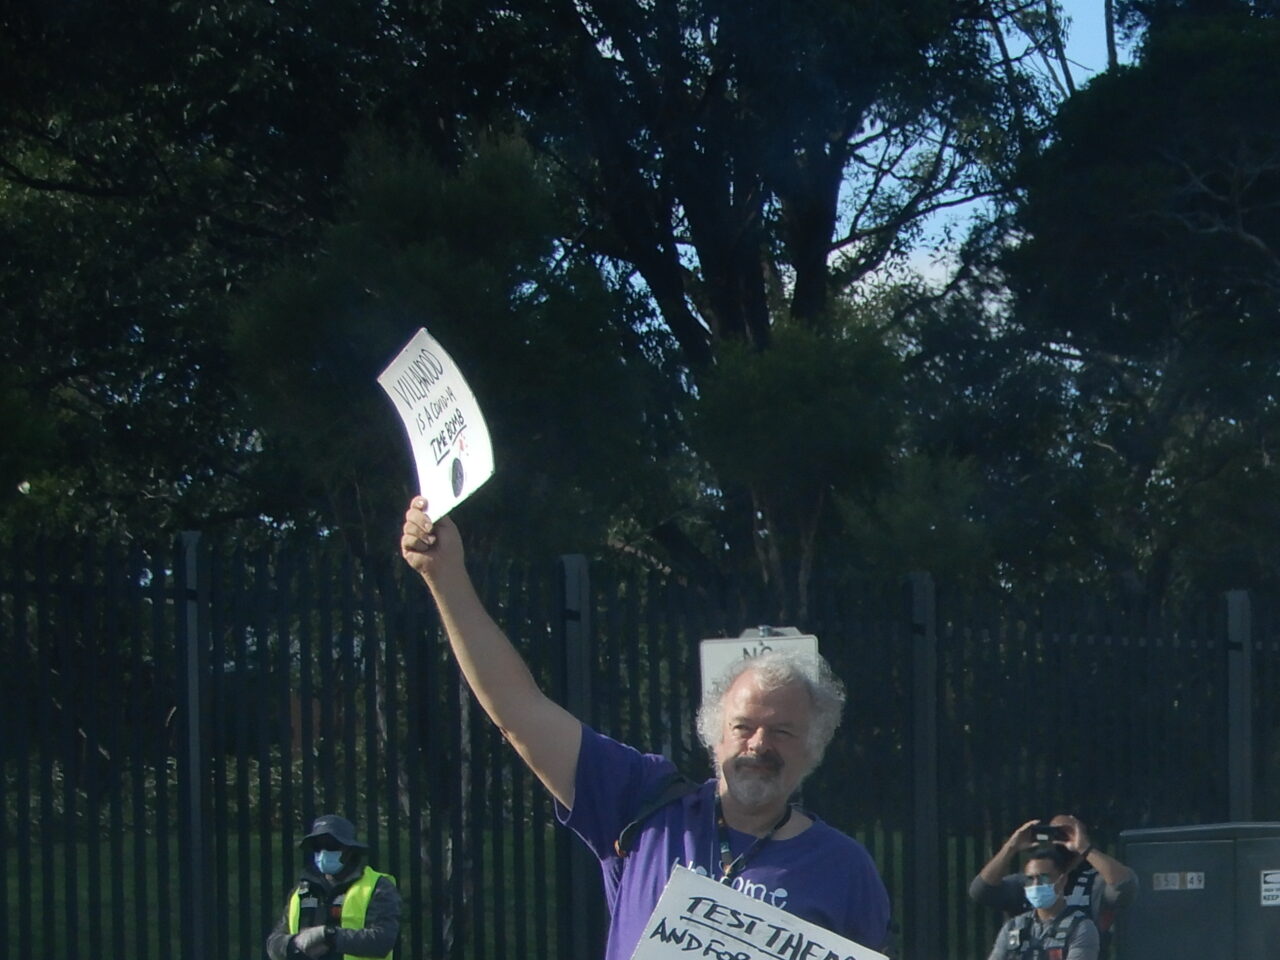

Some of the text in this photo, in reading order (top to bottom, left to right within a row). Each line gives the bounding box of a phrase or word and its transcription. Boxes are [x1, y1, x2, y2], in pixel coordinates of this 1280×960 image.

[444, 407, 465, 440] BOMB
[687, 896, 764, 936] TEST
[650, 918, 703, 952] AND
